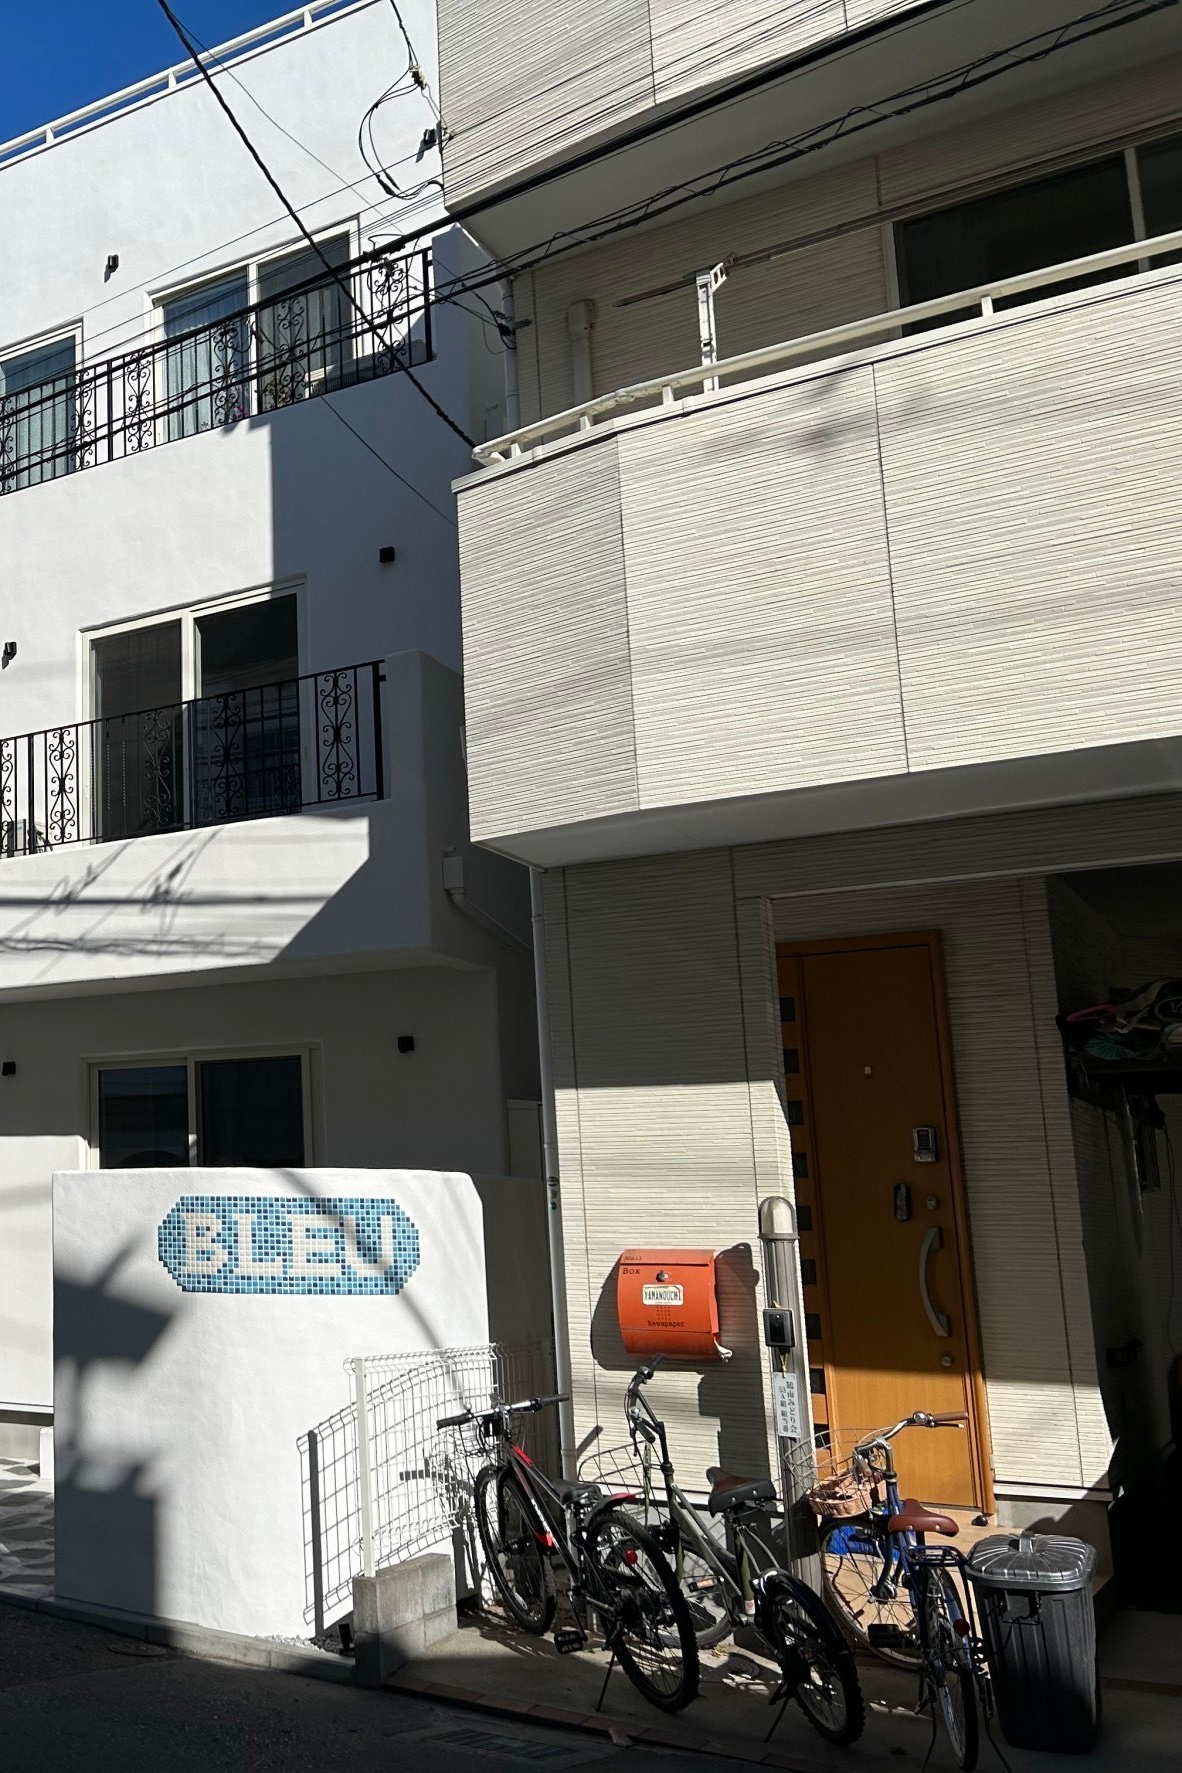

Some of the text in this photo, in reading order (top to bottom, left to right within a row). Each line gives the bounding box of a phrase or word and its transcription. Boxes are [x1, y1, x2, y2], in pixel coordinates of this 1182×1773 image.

[182, 1212, 393, 1277] BLEU
[622, 1267, 641, 1275] Box
[644, 1290, 682, 1301] YAMANOUCHI
[647, 1319, 685, 1328] Newspaper
